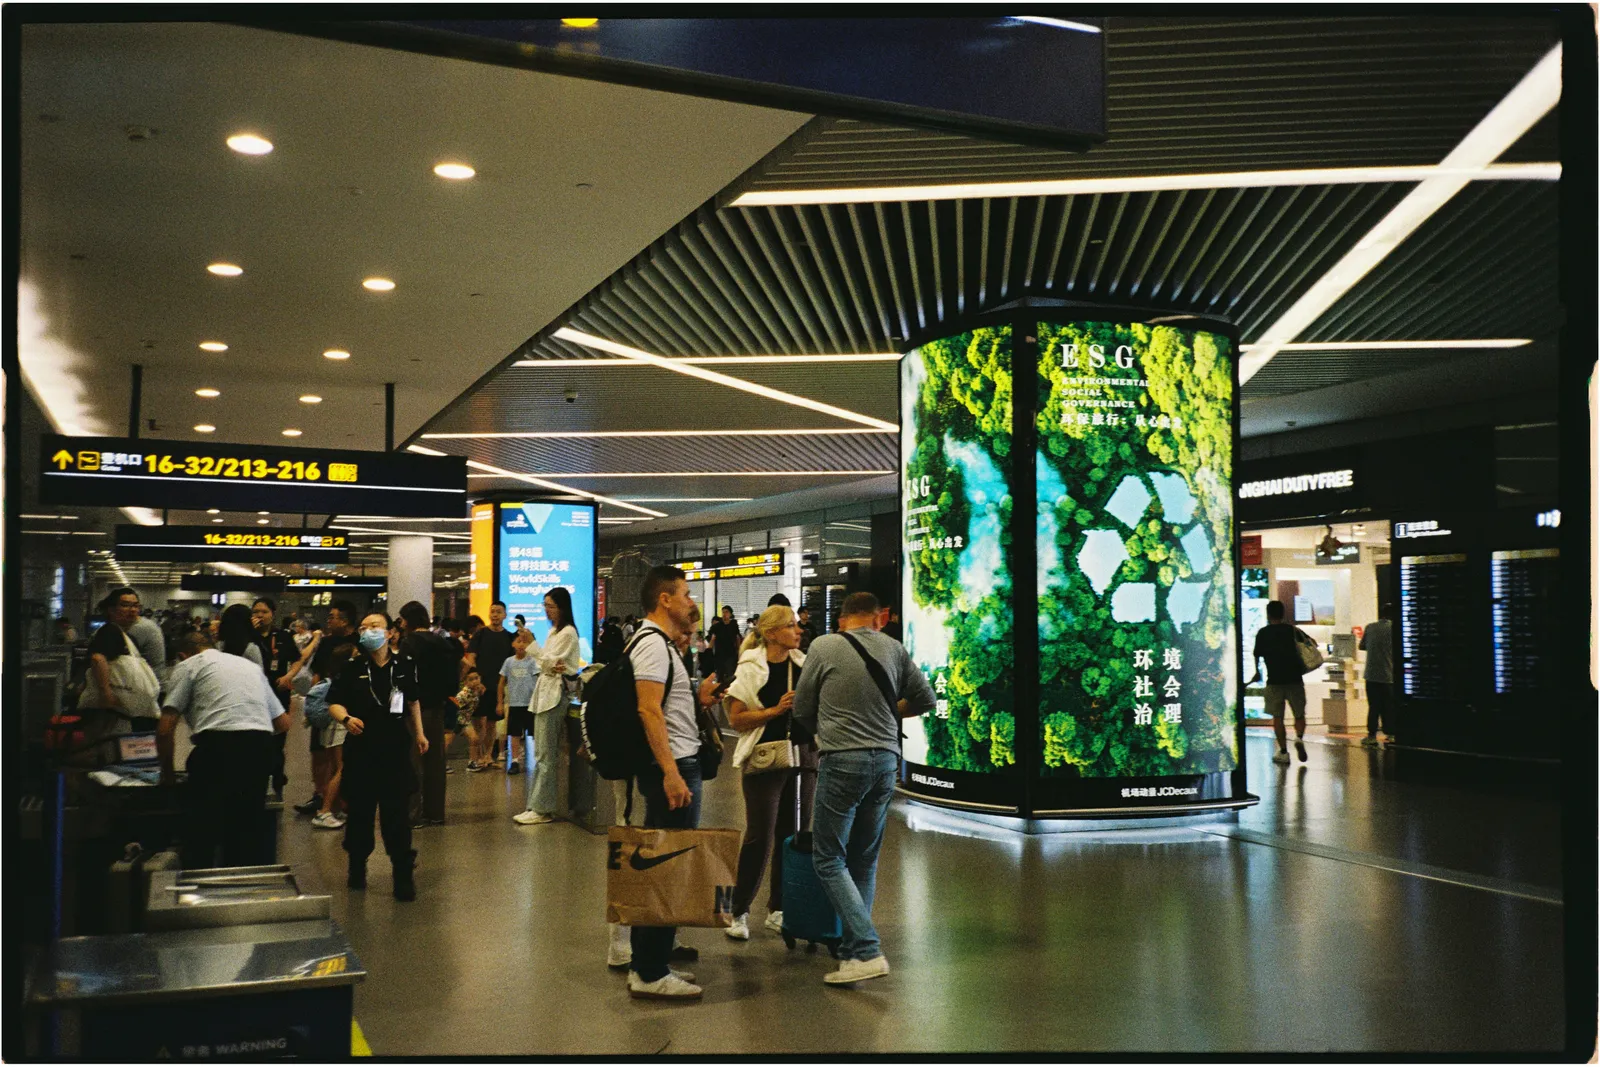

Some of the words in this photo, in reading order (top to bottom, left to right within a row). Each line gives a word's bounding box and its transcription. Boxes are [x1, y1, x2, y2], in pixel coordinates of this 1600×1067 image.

[1060, 344, 1135, 369] ESG
[1061, 377, 1150, 387] ENVIRONMENTAL
[1061, 399, 1135, 409] GOVERNANCE
[145, 455, 321, 480] 16-32/213-216
[1239, 479, 1283, 499] NGHAI
[1282, 474, 1319, 494] DUTY
[1317, 469, 1354, 489] FREE
[204, 534, 300, 547] 16-32/213-216
[509, 574, 560, 583] WorldSkills
[1157, 786, 1198, 796] JCDecaux
[216, 1038, 287, 1054] WARNING
